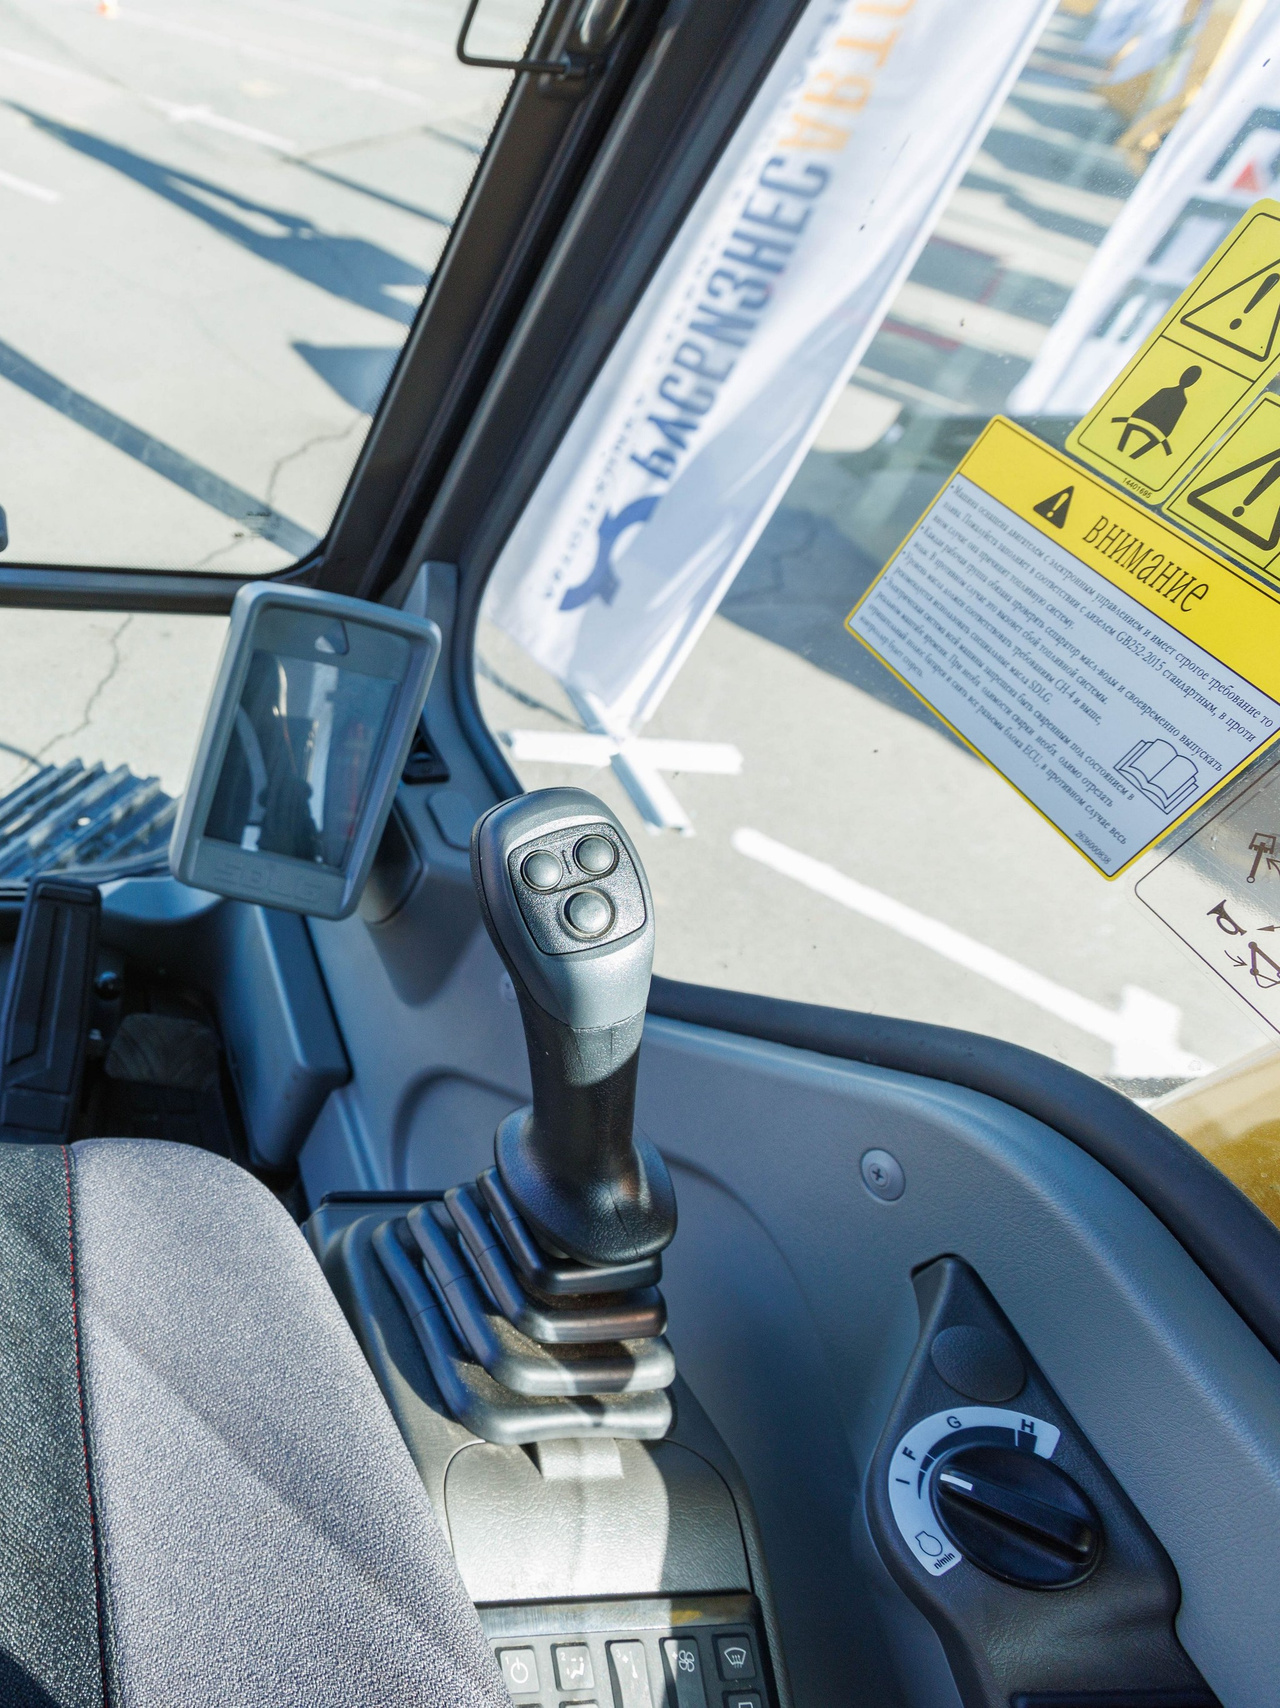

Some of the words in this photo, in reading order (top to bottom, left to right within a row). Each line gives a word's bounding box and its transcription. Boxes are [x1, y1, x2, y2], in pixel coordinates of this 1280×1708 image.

[1122, 477, 1152, 499] 14401695
[1044, 601, 1075, 630] систему.
[1033, 570, 1081, 608] соответствии
[1078, 604, 1087, 613] с
[1083, 608, 1117, 636] дизелем
[1114, 629, 1167, 671] GB252-2015
[1161, 667, 1219, 716] стандартным,
[1218, 711, 1228, 720] в
[1225, 716, 1257, 742] проти
[1047, 557, 1096, 596] электронным
[1091, 591, 1145, 631] управлением
[1142, 627, 1152, 637] и
[1149, 633, 1177, 655] имеет
[1174, 651, 1210, 680] строгое
[1207, 676, 1262, 718] требование
[1258, 714, 1275, 727] то
[1008, 664, 1030, 685] масла
[1027, 679, 1053, 704] SDLG.
[1011, 644, 1056, 683] требованиям
[1053, 677, 1077, 699] CH-4
[1072, 695, 1082, 704] и
[1078, 701, 1103, 725] выше,
[1020, 629, 1042, 647] сбой
[1037, 643, 1080, 677] топливной
[1075, 674, 1109, 704] системы.
[1043, 624, 1081, 659] сепаратор
[1078, 652, 1119, 687] масл-воды
[1116, 683, 1126, 693] и
[1123, 689, 1181, 737] своевременно
[1178, 733, 1225, 771] выпускать
[980, 685, 1013, 715] одимости
[1010, 712, 1035, 735] сварки
[1034, 734, 1058, 756] необх
[1057, 754, 1083, 779] одимо
[1080, 775, 1115, 807] отрезать
[1015, 691, 1035, 712] быть
[1032, 708, 1072, 744] сваренным
[1069, 741, 1087, 757] под
[1083, 754, 1129, 795] состоянием
[1126, 792, 1136, 800] в
[1002, 725, 1024, 749] блока
[1021, 743, 1043, 767] ECU,
[1039, 762, 1048, 771] в
[1045, 767, 1086, 806] противном
[1083, 803, 1111, 829] случае
[1108, 826, 1128, 845] весь
[1074, 830, 1112, 865] 2636000838
[946, 1415, 962, 1429] G
[1021, 1418, 1035, 1433] H
[902, 1446, 916, 1461] F
[933, 1551, 956, 1570] n/min
[560, 1651, 567, 1661] 2
